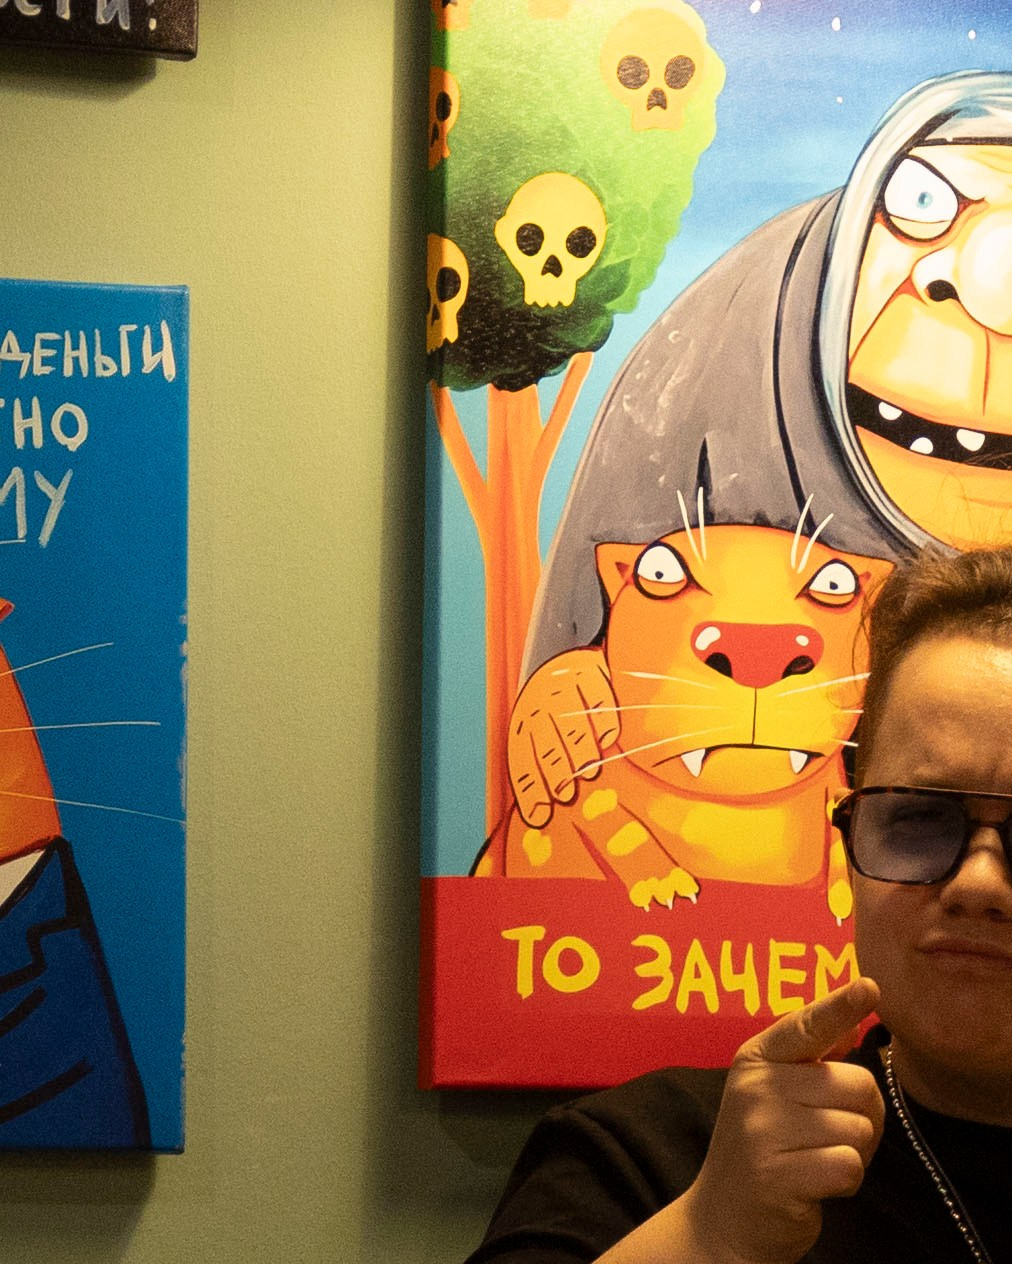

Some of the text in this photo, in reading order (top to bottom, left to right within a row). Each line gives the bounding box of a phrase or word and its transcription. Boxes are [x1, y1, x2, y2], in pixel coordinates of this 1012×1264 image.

[0, 320, 176, 383] ДЕНЬГИ
[0, 396, 89, 452] НО
[501, 925, 601, 1000] ТО
[630, 934, 861, 1017] ЗАЧЕМ
